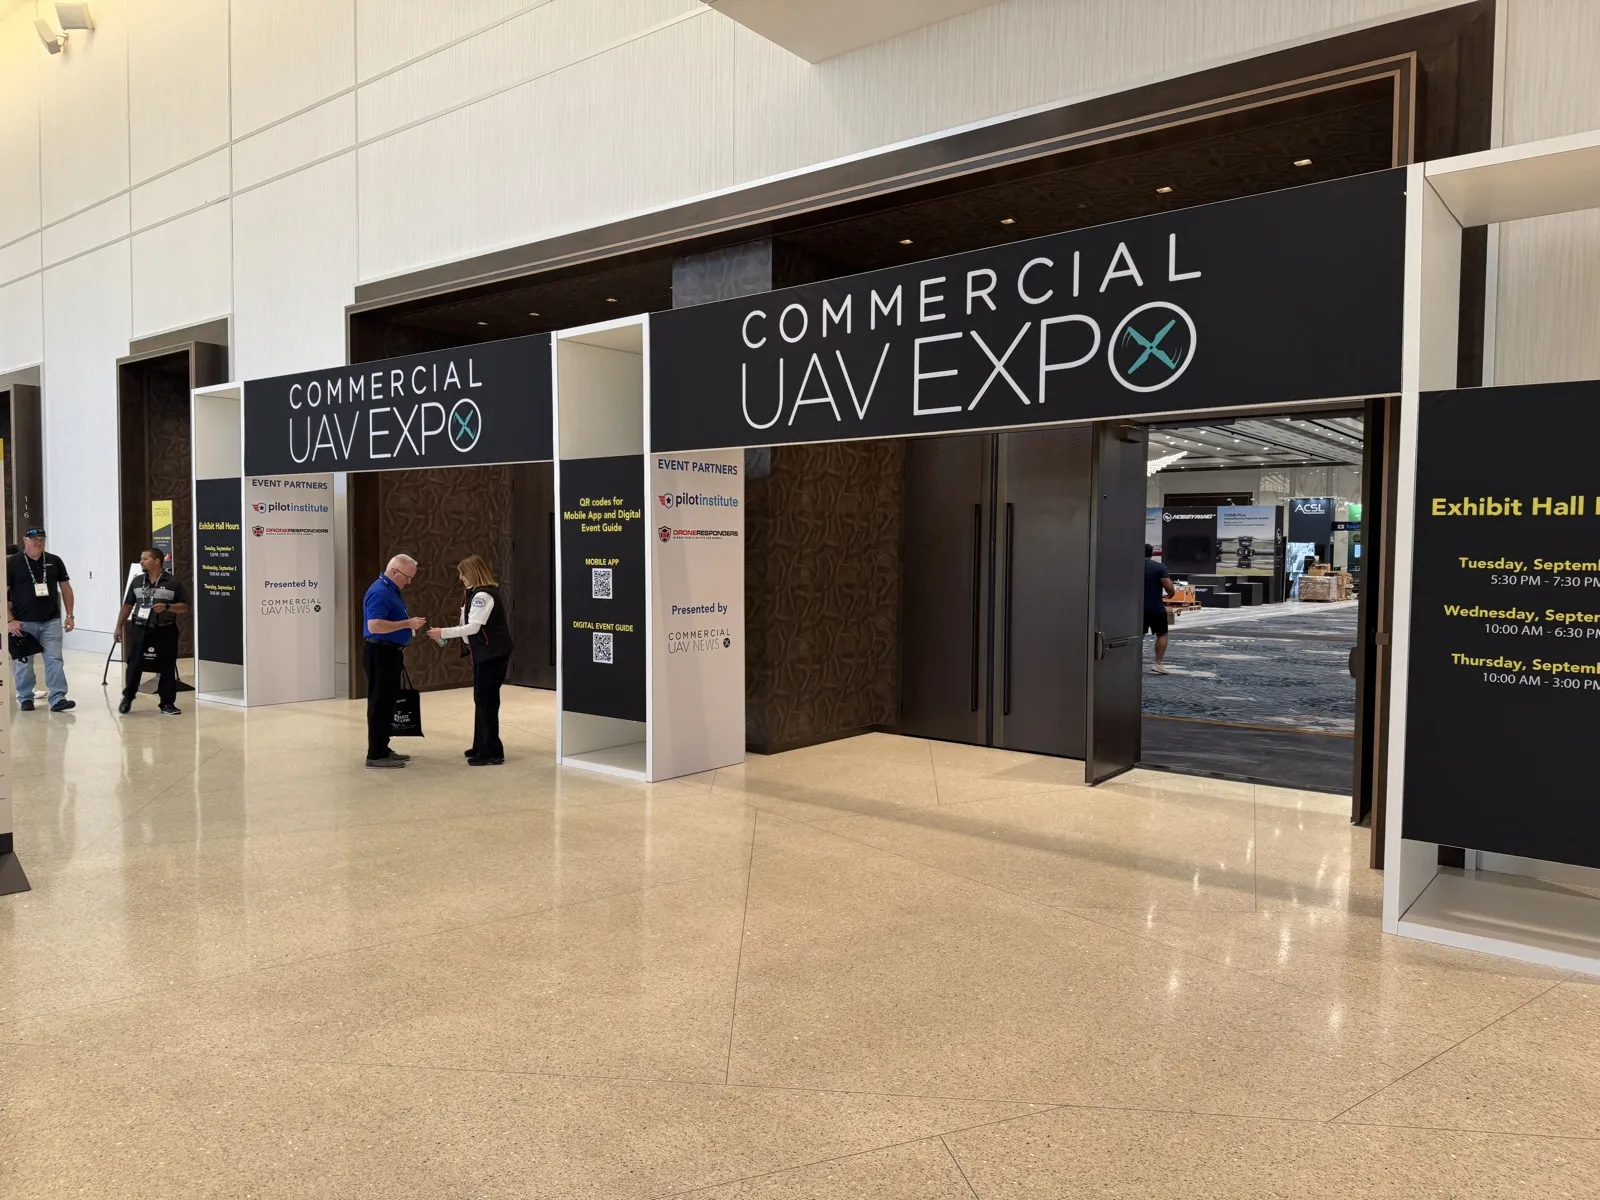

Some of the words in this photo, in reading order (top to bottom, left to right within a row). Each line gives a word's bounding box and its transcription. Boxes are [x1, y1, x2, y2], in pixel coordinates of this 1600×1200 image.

[742, 233, 1202, 349] COMMERCIAL
[742, 342, 890, 430] UAV
[913, 301, 1197, 416] EXPO
[289, 358, 482, 409] COMMERCIAL
[289, 411, 359, 463] UAV
[369, 398, 482, 459] EXPO
[658, 459, 689, 471] EVENT
[692, 462, 738, 475] PARTNERS
[252, 479, 282, 488] EVENT
[284, 480, 328, 490] PARTNERS
[579, 497, 591, 507] QR
[592, 497, 611, 506] codes
[613, 496, 624, 506] for
[675, 492, 738, 507] pilotinstitute
[1431, 496, 1523, 516] Exhibit
[1532, 495, 1585, 516] Hall
[269, 502, 329, 513] pilotinstitute
[1294, 503, 1325, 514] ACSL
[564, 511, 586, 520] Mobile
[588, 510, 602, 522] App
[603, 509, 616, 519] and
[618, 509, 641, 521] Digital
[199, 522, 215, 530] Exhibit
[215, 521, 225, 530] Hall
[225, 522, 240, 530] Hours
[581, 524, 601, 532] Event
[602, 523, 622, 532] Guide
[585, 558, 606, 566] MOBILE
[608, 558, 620, 566] APP
[1459, 557, 1528, 572] Tuesday,
[1533, 558, 1600, 573] Septem
[264, 580, 306, 589] Presented
[308, 579, 318, 589] by
[1490, 575, 1517, 585] 5:30
[1520, 575, 1541, 586] PM
[1553, 576, 1581, 587] 7:30
[261, 598, 321, 607] COMMERCIAL
[261, 606, 283, 616] UAV
[285, 605, 310, 615] NEWS
[671, 603, 715, 615] Presented
[717, 603, 728, 615] by
[1444, 605, 1539, 622] Wednesday,
[572, 621, 595, 630] DIGITAL
[595, 622, 614, 631] EVENT
[615, 623, 634, 632] GUIDE
[1485, 624, 1518, 635] 10:00
[1521, 625, 1543, 636] AM
[1554, 627, 1583, 638] 6:30
[668, 629, 731, 640] COMMERCIAL
[668, 640, 691, 654] UAV
[693, 638, 720, 652] NEWS
[1451, 653, 1527, 672] Thursday,
[1482, 672, 1516, 684] 10:00
[1519, 674, 1541, 686] AM
[1552, 678, 1580, 689] 3:00
